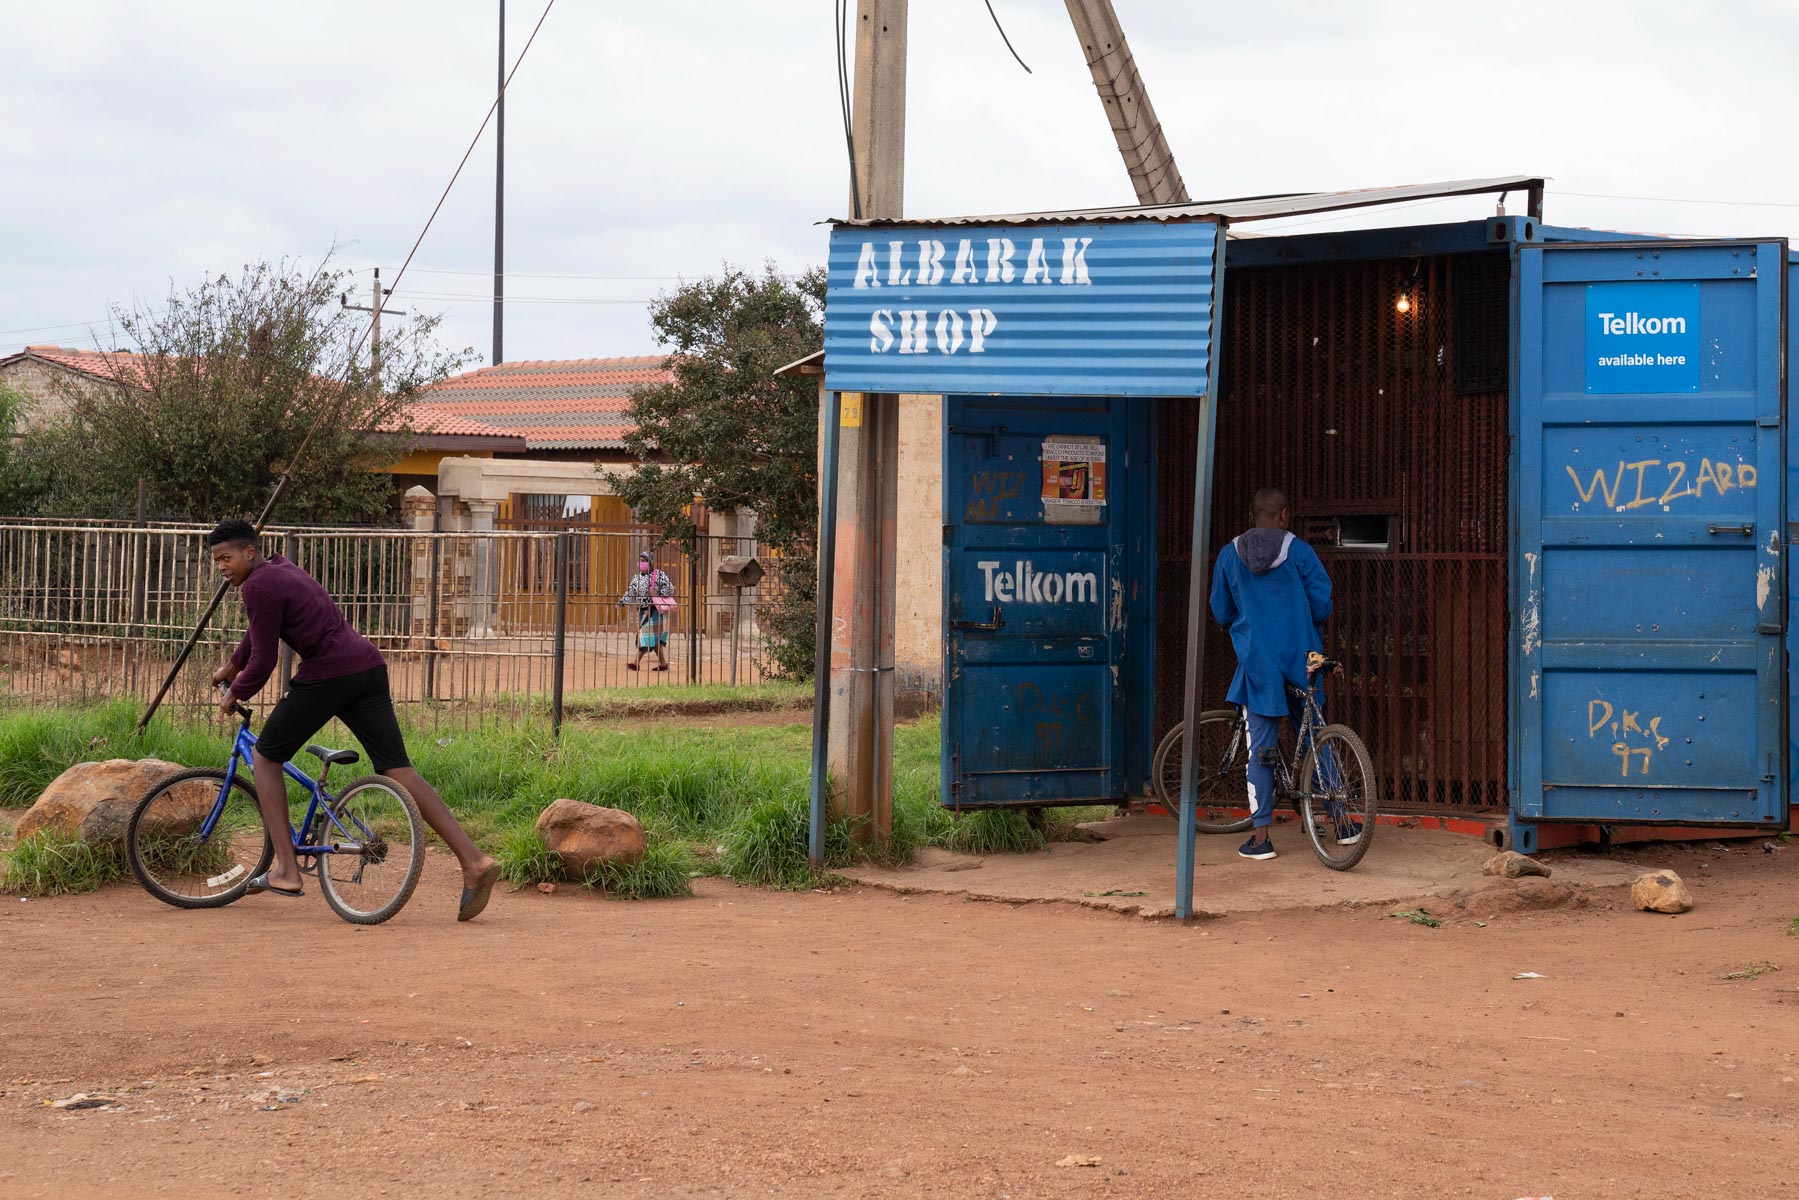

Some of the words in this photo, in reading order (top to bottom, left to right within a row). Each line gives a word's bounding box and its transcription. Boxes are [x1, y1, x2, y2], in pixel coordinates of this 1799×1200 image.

[853, 237, 1093, 288] ALBARAK
[870, 309, 998, 354] SHOP
[1599, 312, 1686, 335] Telkom
[1599, 353, 1654, 366] available
[1657, 353, 1686, 366] here
[977, 560, 1098, 603] Telkom
